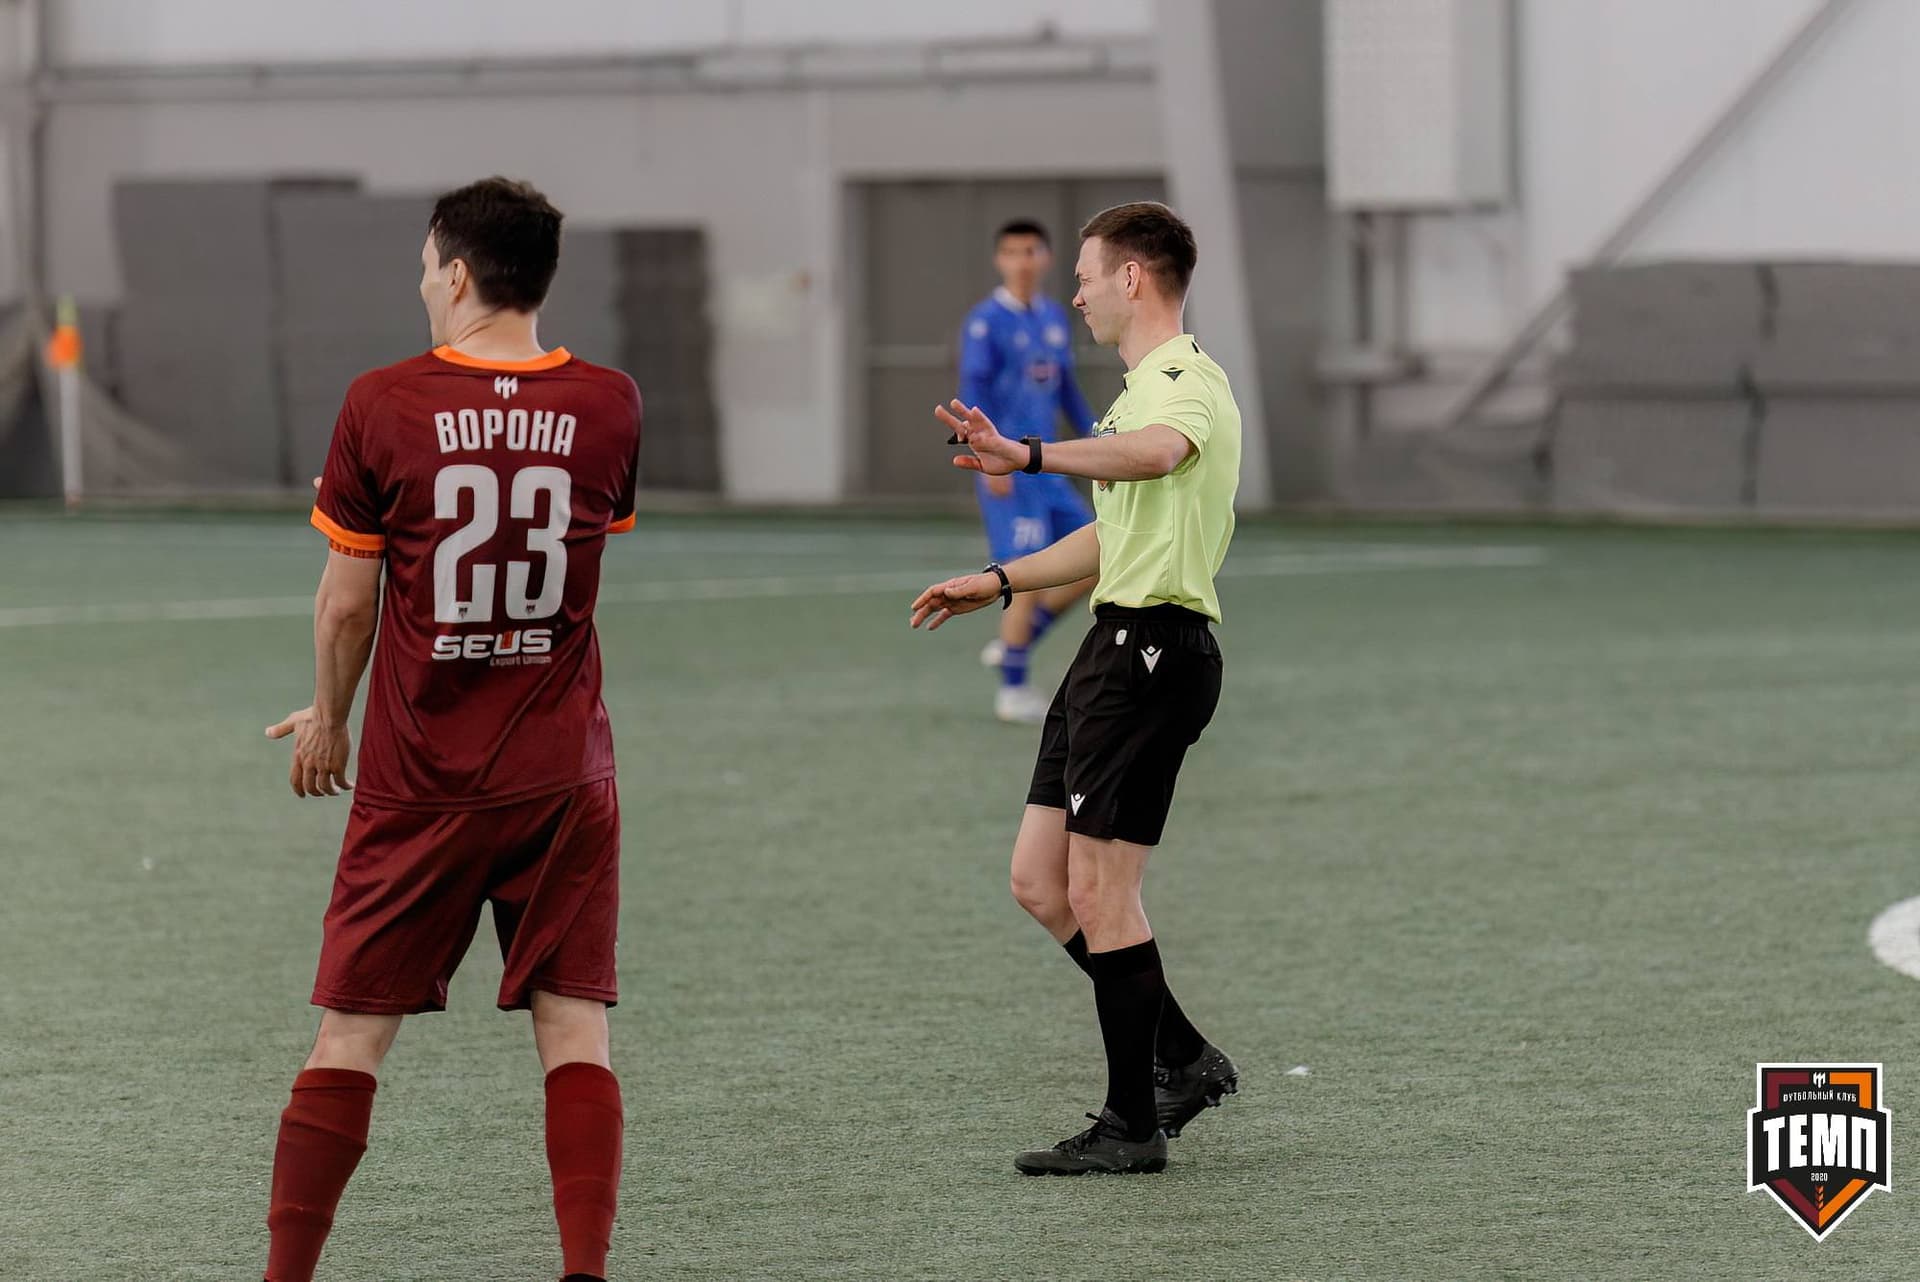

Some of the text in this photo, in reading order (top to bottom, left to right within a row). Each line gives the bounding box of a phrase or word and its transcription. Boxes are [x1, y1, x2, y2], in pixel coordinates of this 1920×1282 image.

[434, 408, 577, 457] ВОРОНА
[434, 464, 572, 624] 23
[431, 628, 553, 660] SEUS
